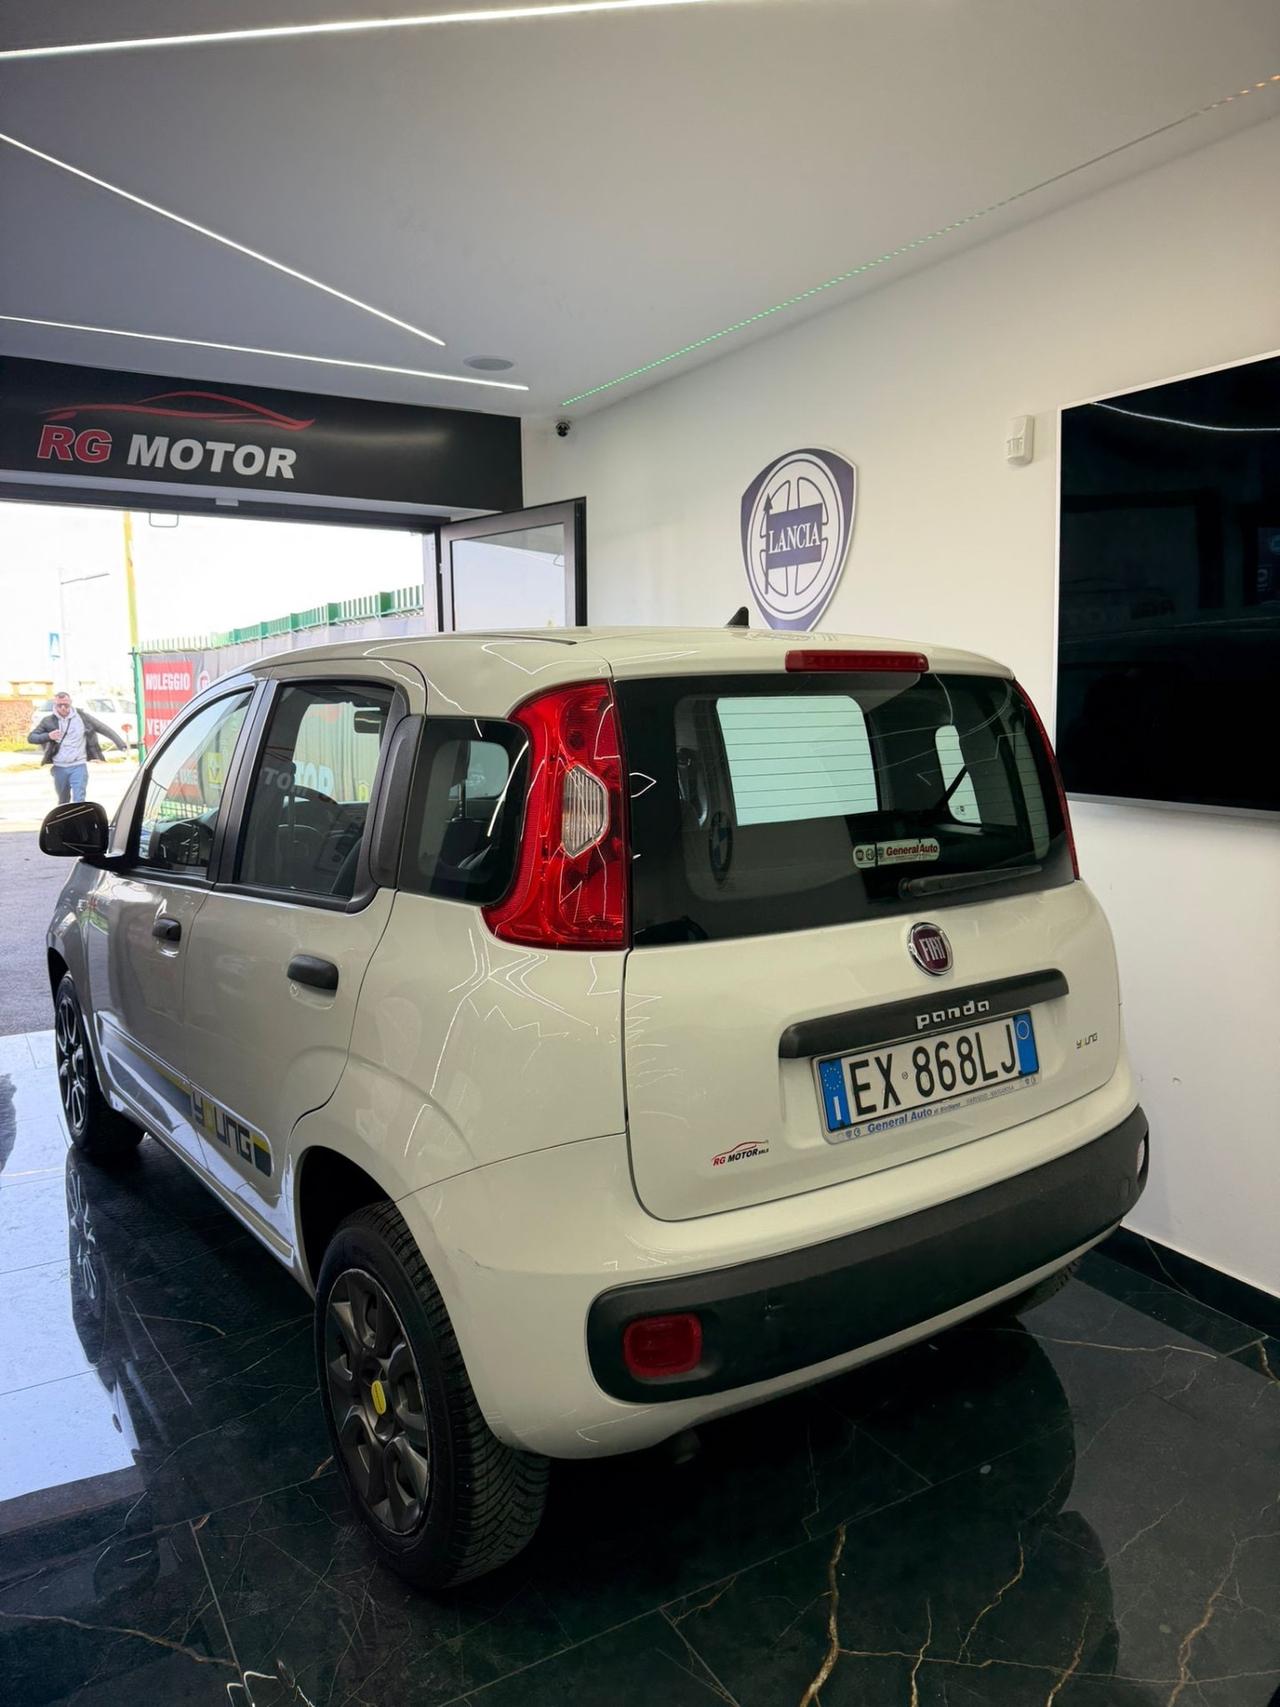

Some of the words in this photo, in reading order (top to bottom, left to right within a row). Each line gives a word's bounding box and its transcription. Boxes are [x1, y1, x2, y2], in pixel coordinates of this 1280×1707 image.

[36, 424, 113, 464] RG
[126, 433, 298, 480] MOTOR
[768, 521, 822, 555] LANCIA
[919, 936, 946, 962] FIAT
[916, 1000, 990, 1030] panda
[849, 1053, 902, 1117] EX
[912, 1023, 1017, 1099] 868LJ
[867, 1113, 908, 1135] General
[910, 1107, 933, 1124] Auto
[713, 1156, 726, 1167] RG
[727, 1148, 758, 1163] MOTOR
